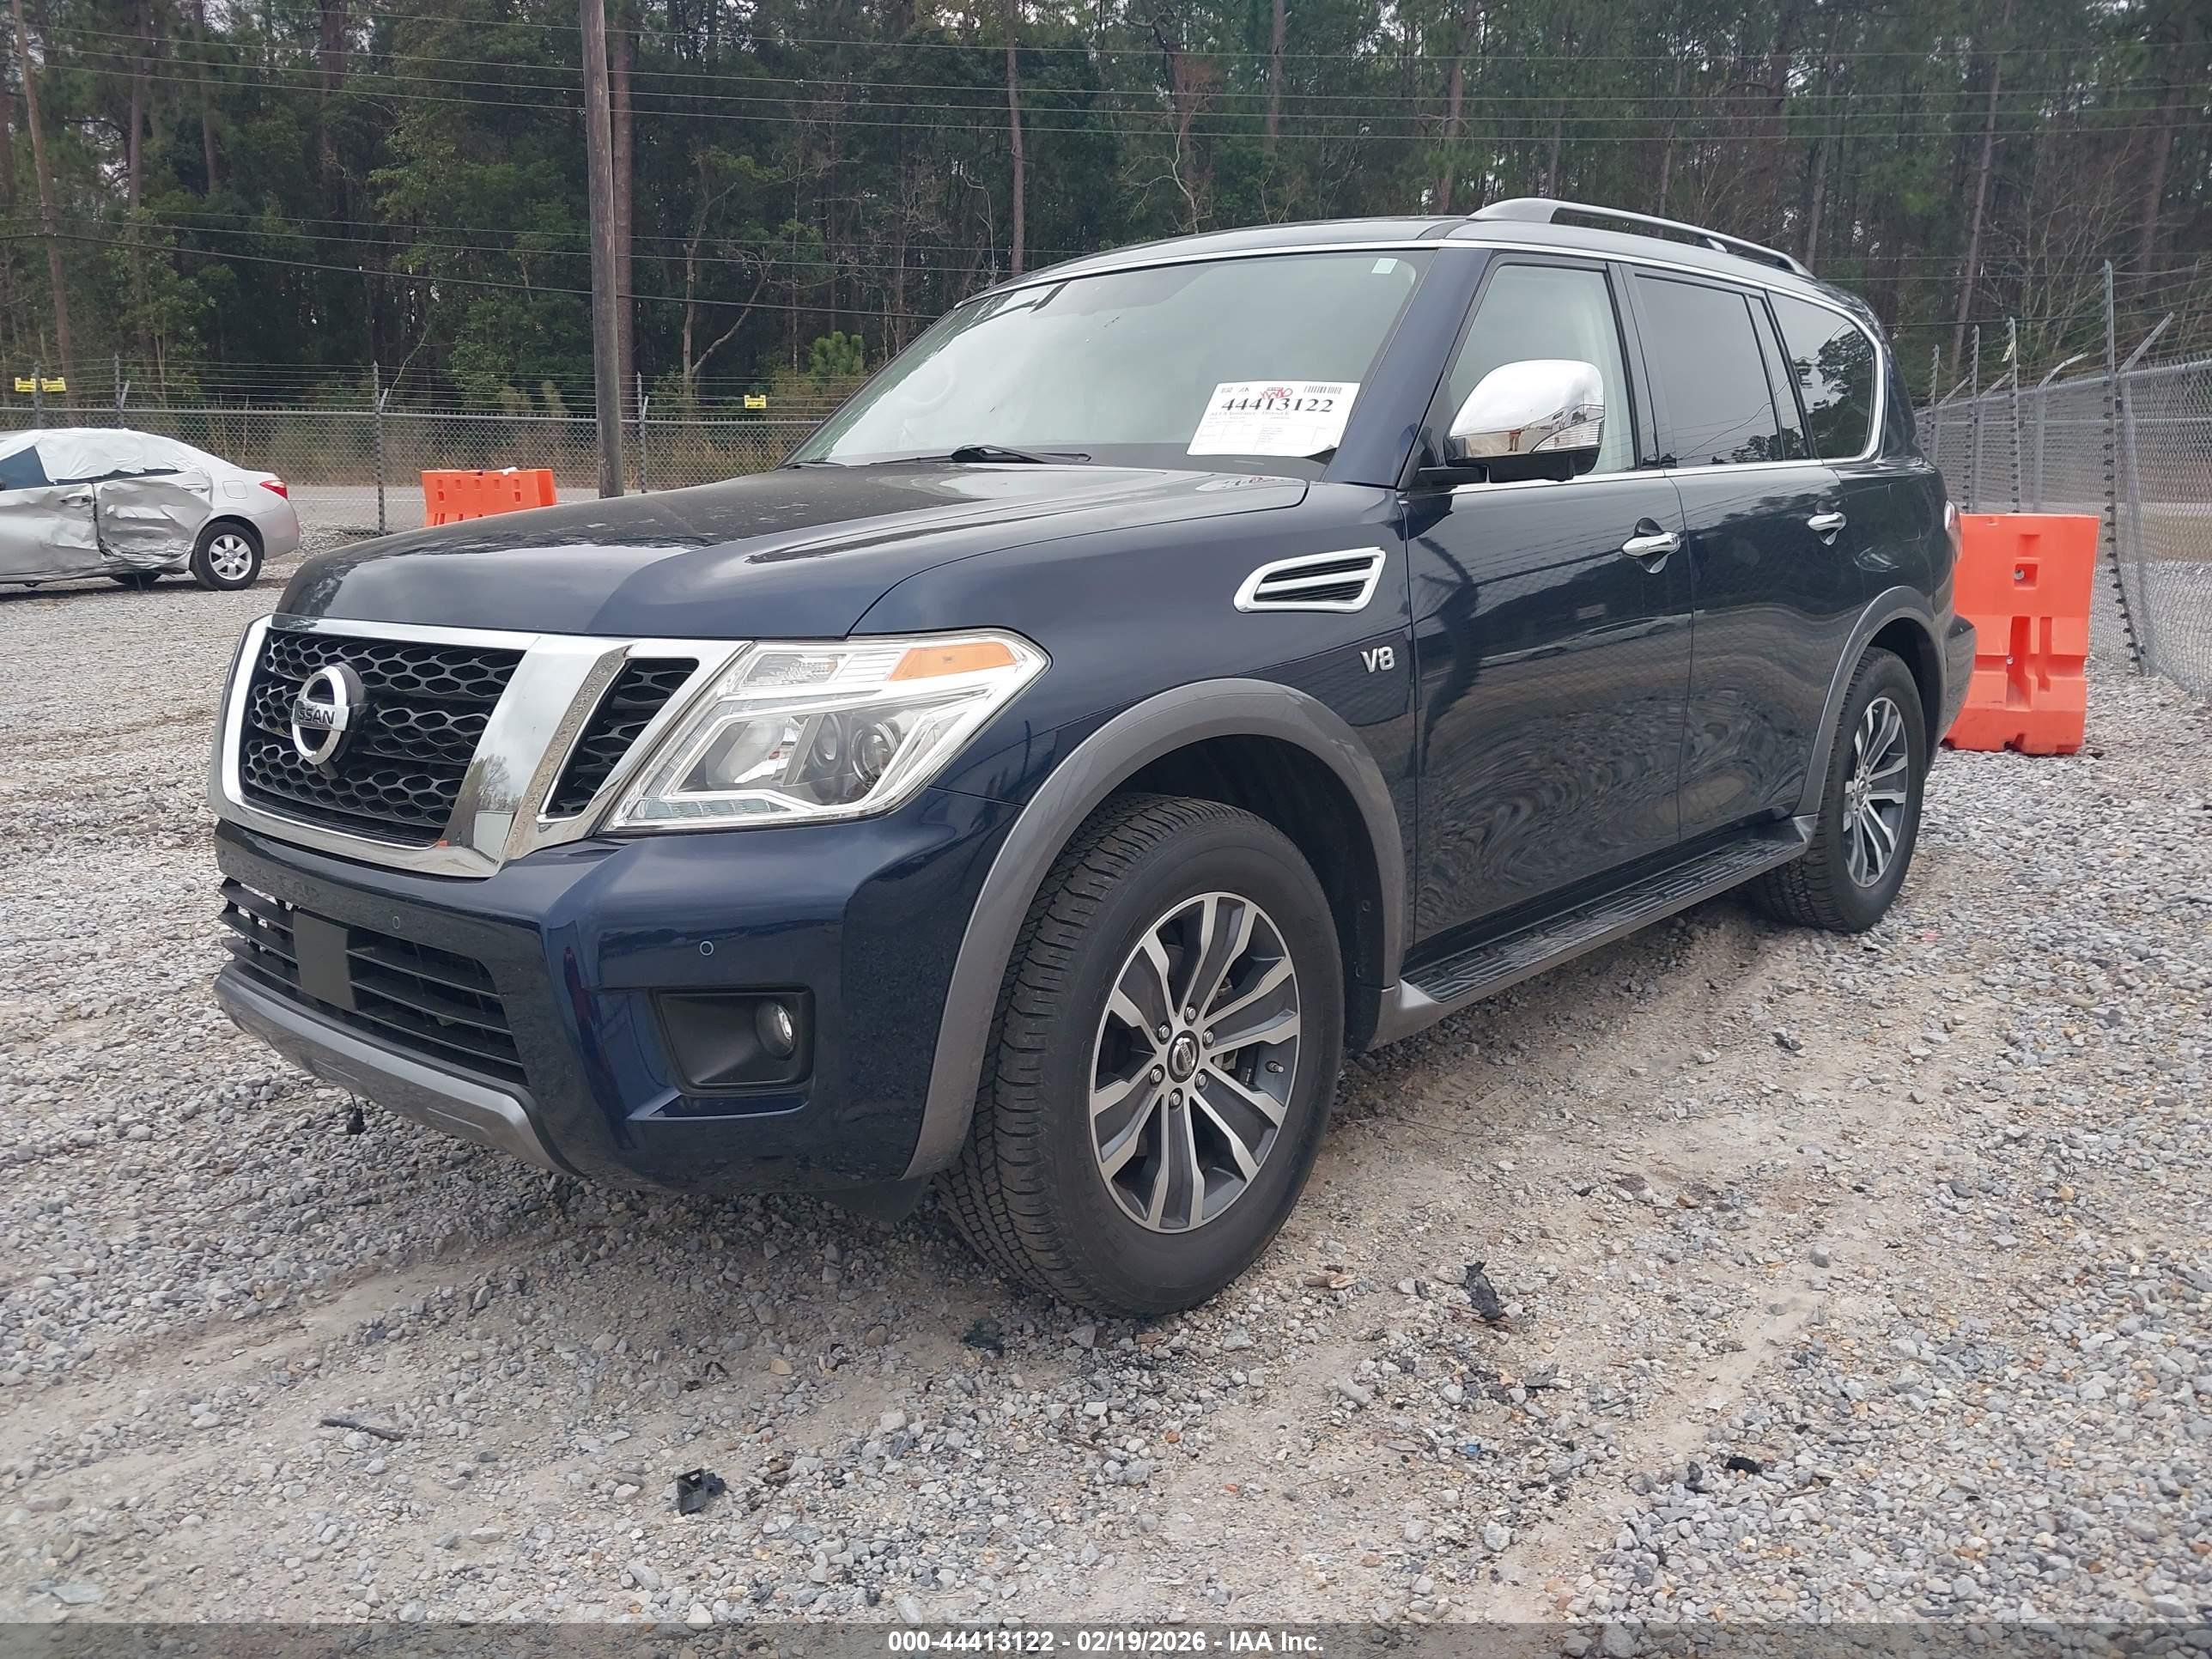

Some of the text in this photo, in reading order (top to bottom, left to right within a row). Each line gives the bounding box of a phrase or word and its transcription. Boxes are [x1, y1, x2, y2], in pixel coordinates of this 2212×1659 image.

[1221, 398, 1334, 412] 44413122
[1359, 647, 1395, 673] V8
[295, 705, 336, 725] SSAN
